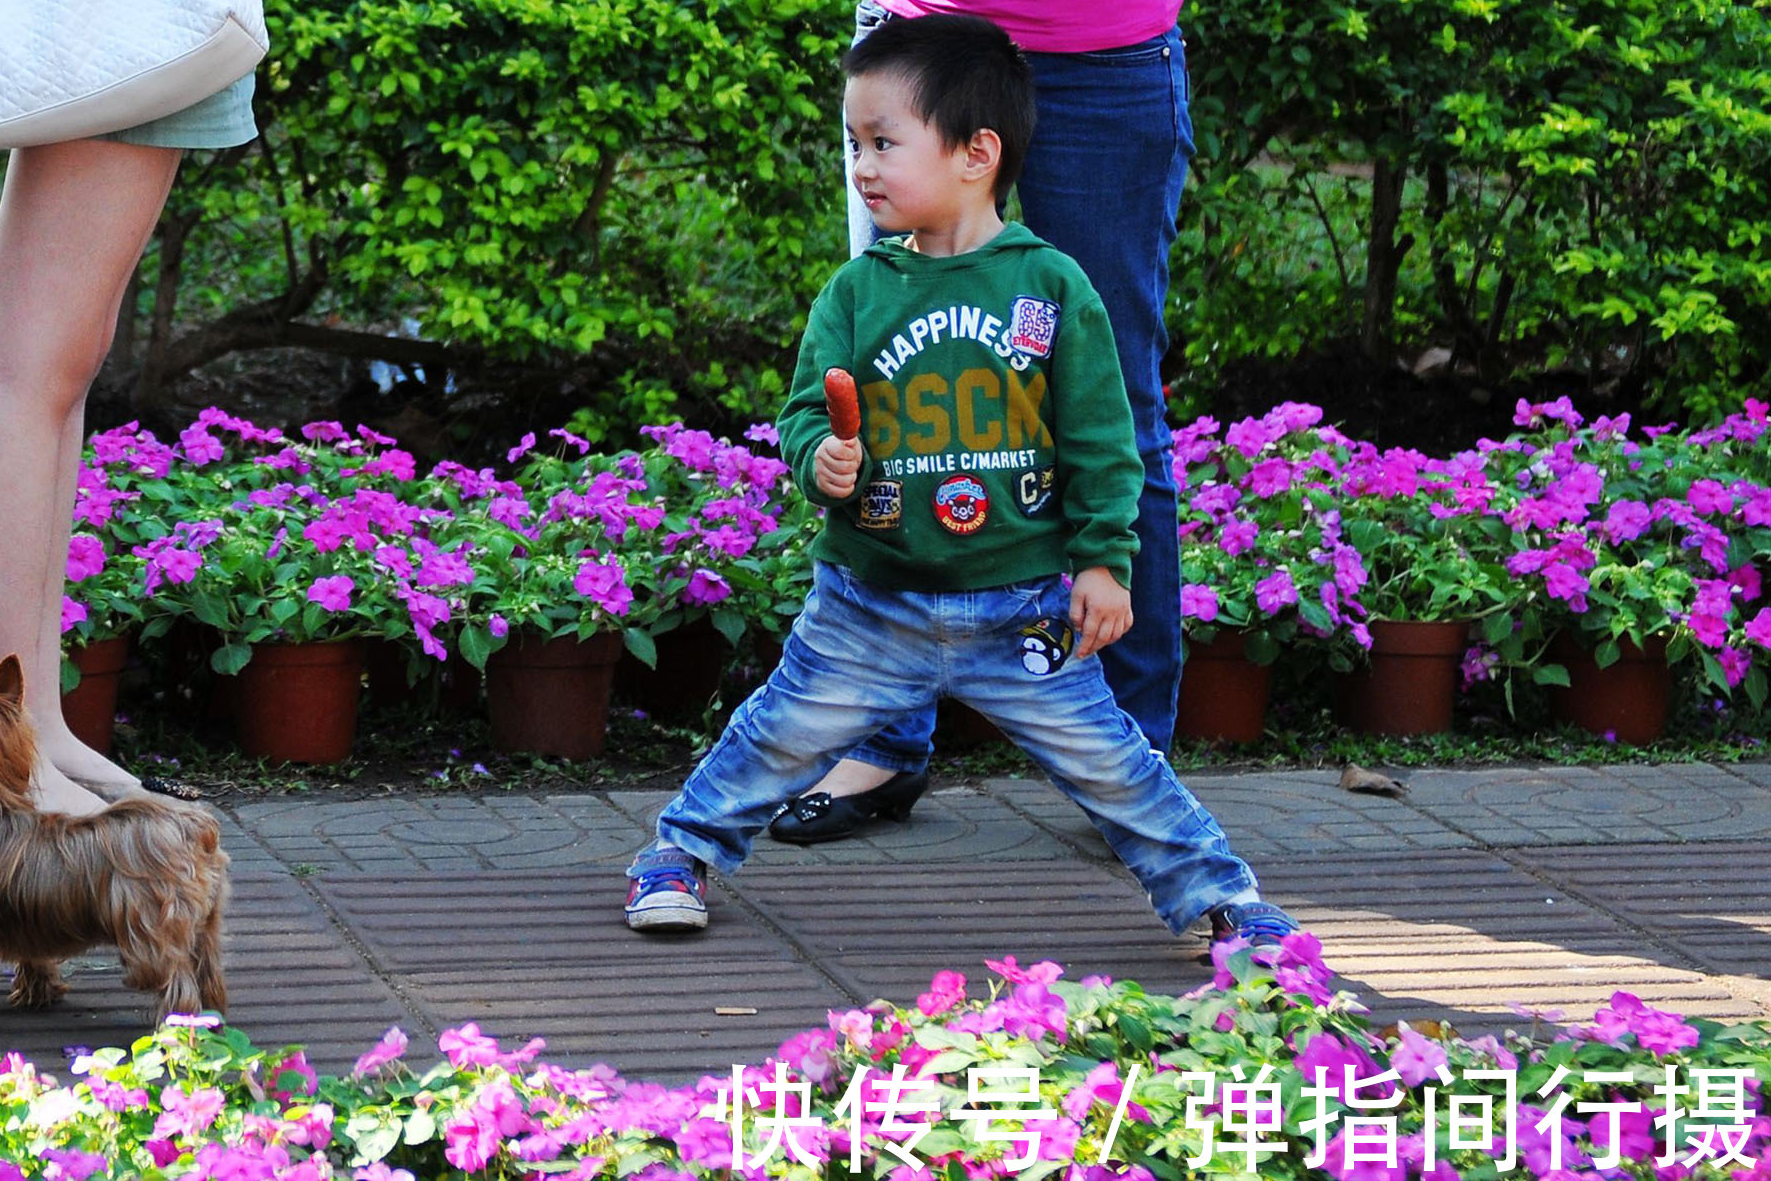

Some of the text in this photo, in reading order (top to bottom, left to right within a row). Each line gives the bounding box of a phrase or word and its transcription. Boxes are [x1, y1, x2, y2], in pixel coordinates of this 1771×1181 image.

[861, 368, 1054, 457] BSCM
[882, 449, 1036, 477] BIG SMILE C/MARKET
